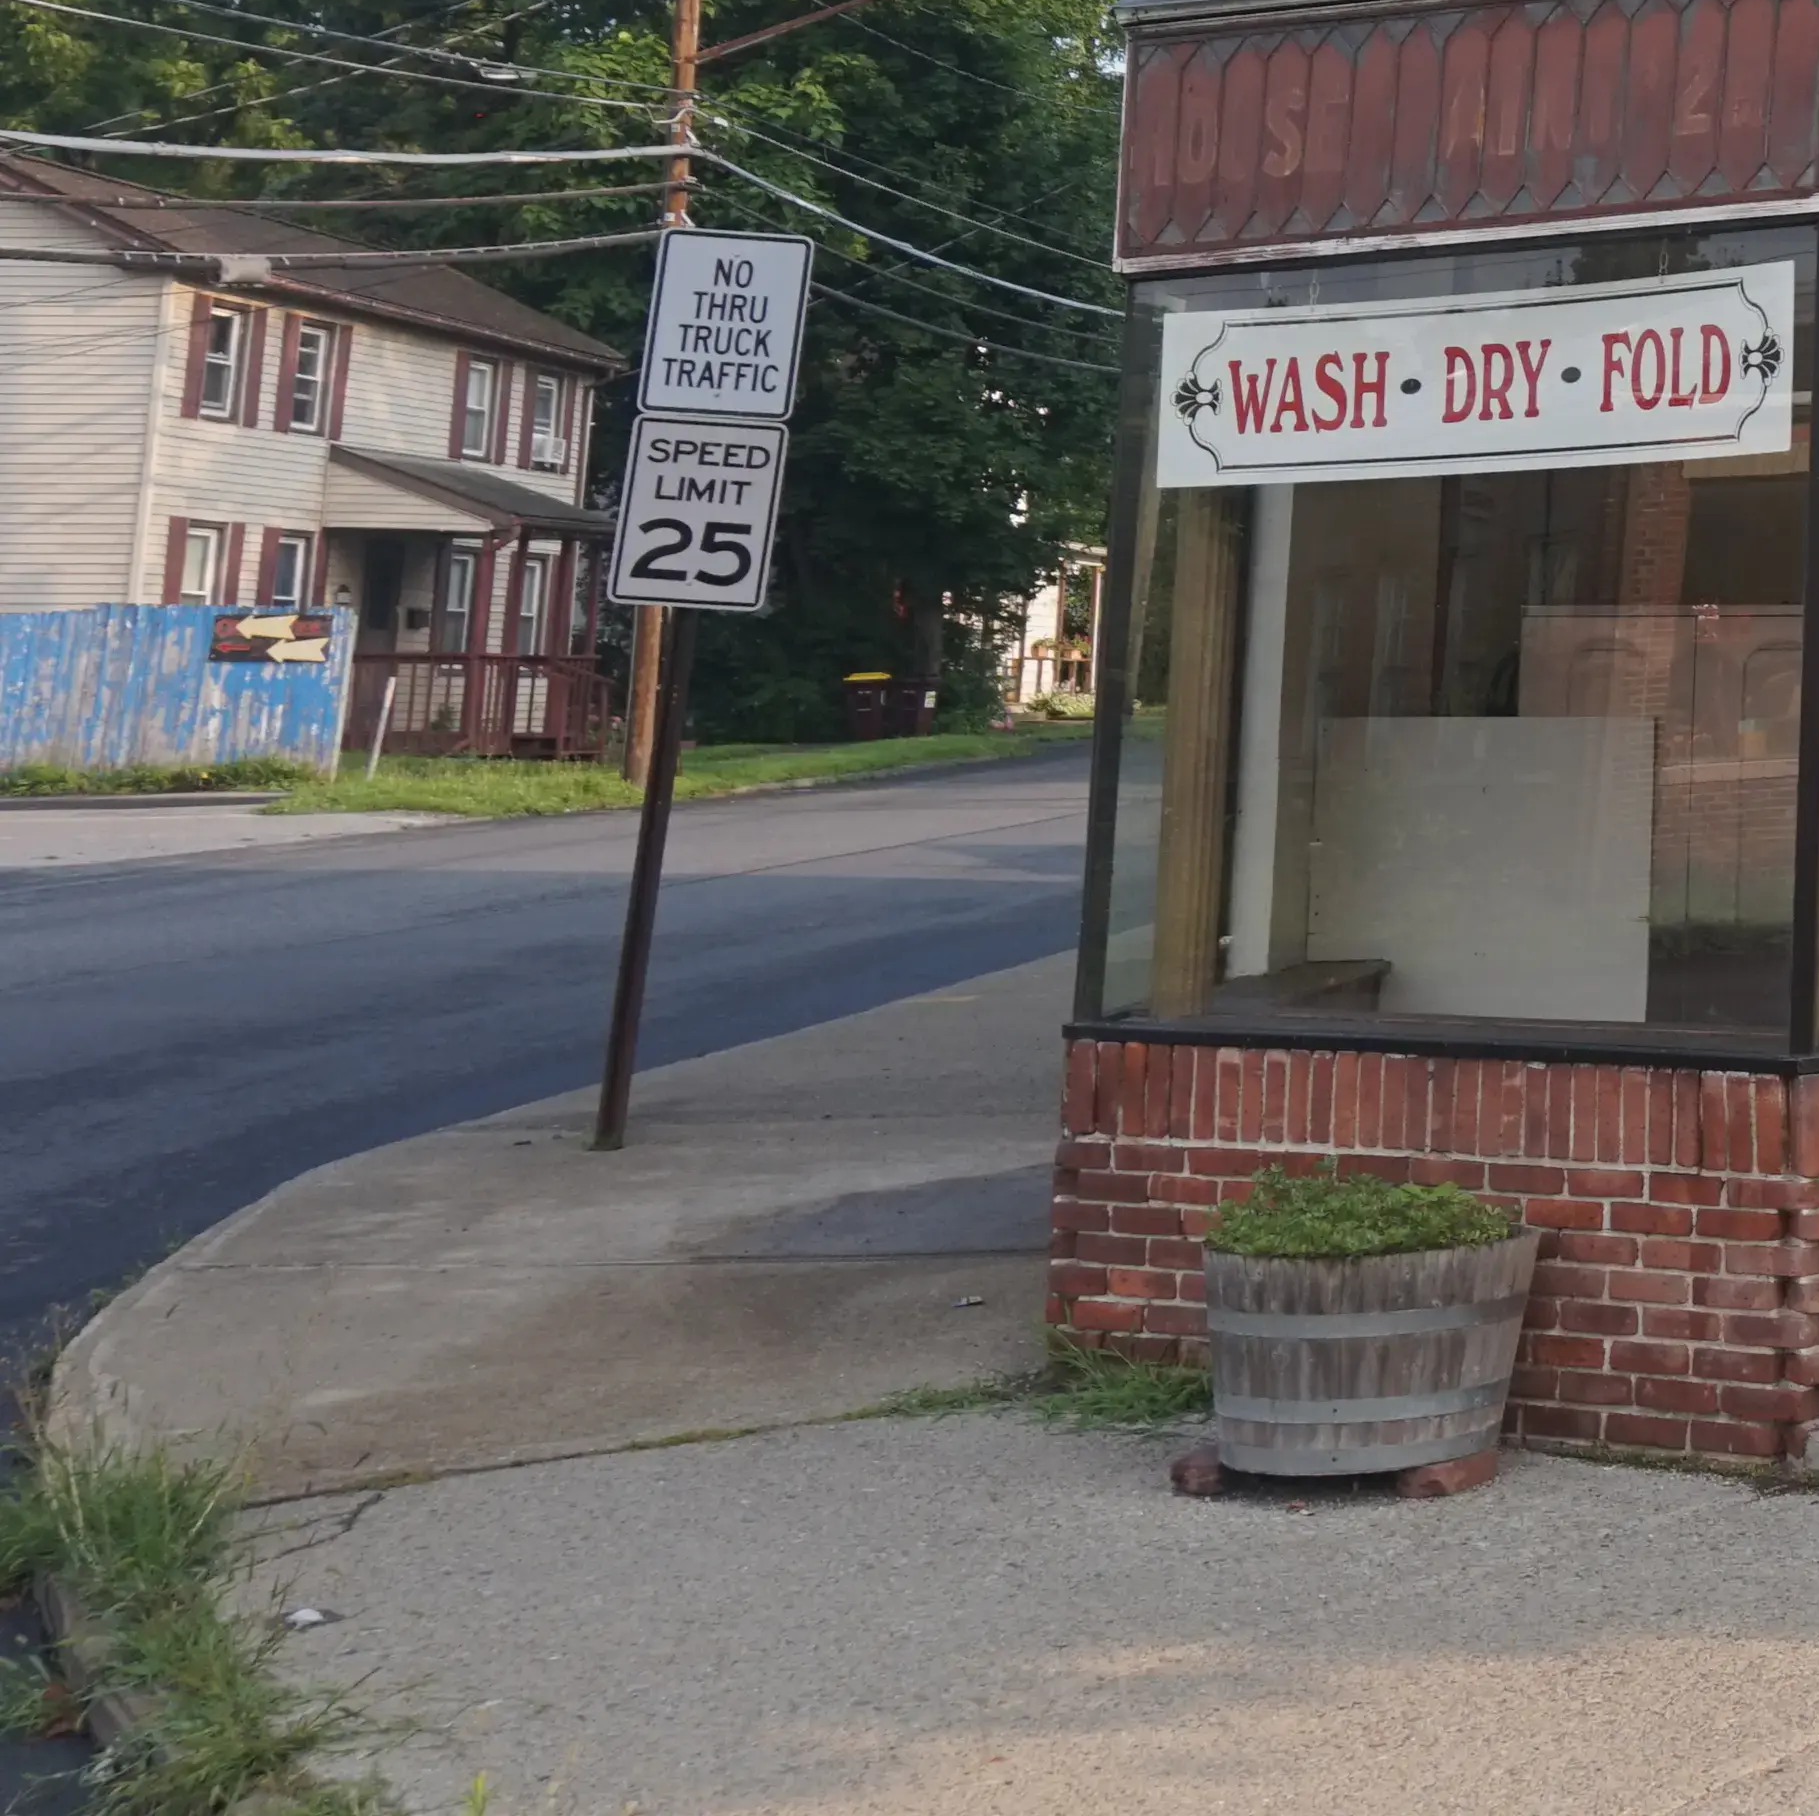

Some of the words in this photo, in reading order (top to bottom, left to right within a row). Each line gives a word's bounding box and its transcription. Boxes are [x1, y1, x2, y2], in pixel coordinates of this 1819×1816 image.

[713, 257, 755, 289] NO
[692, 290, 769, 324] THRU
[678, 323, 772, 358] TRUCK
[661, 356, 780, 393] TRAFFIC
[1227, 350, 1392, 435] WASH
[1441, 337, 1553, 424] DRY
[1598, 321, 1733, 413] FOLD
[646, 437, 771, 470] SPEED
[654, 475, 753, 506] LIMIT
[629, 517, 752, 587] 25
